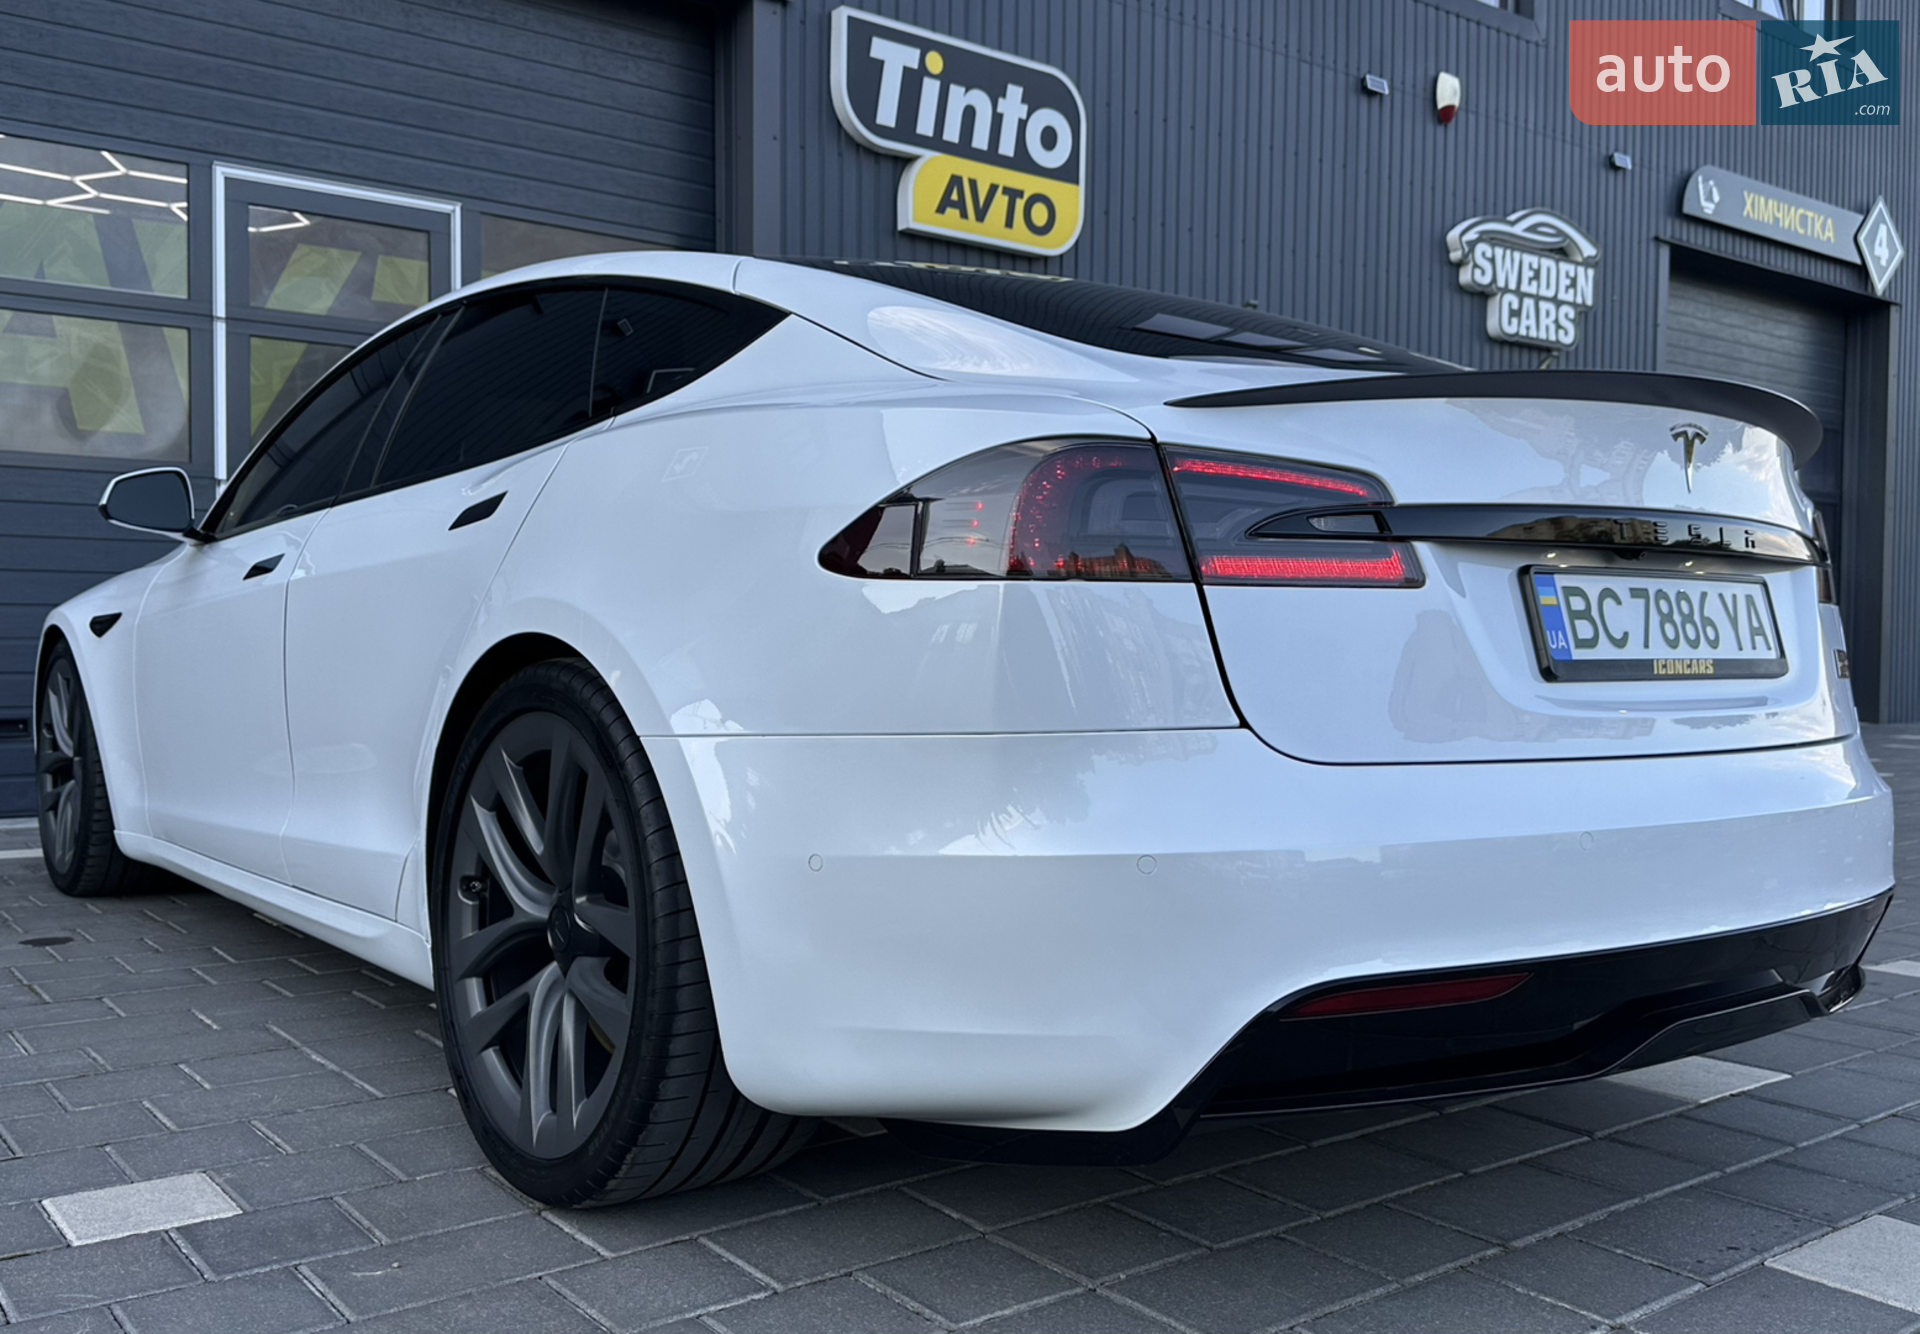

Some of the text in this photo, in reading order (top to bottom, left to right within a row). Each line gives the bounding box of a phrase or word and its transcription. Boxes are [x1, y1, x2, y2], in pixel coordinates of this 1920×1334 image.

[869, 36, 1073, 169] Tinto
[935, 173, 1057, 236] AVTO
[1743, 190, 1835, 244] ХІМЧИСТКА
[1873, 222, 1889, 268] 4
[1473, 242, 1595, 307] SWEDEN
[1501, 292, 1576, 345] CARS
[1547, 629, 1568, 649] UA
[1653, 659, 1714, 675] ICONCARS
